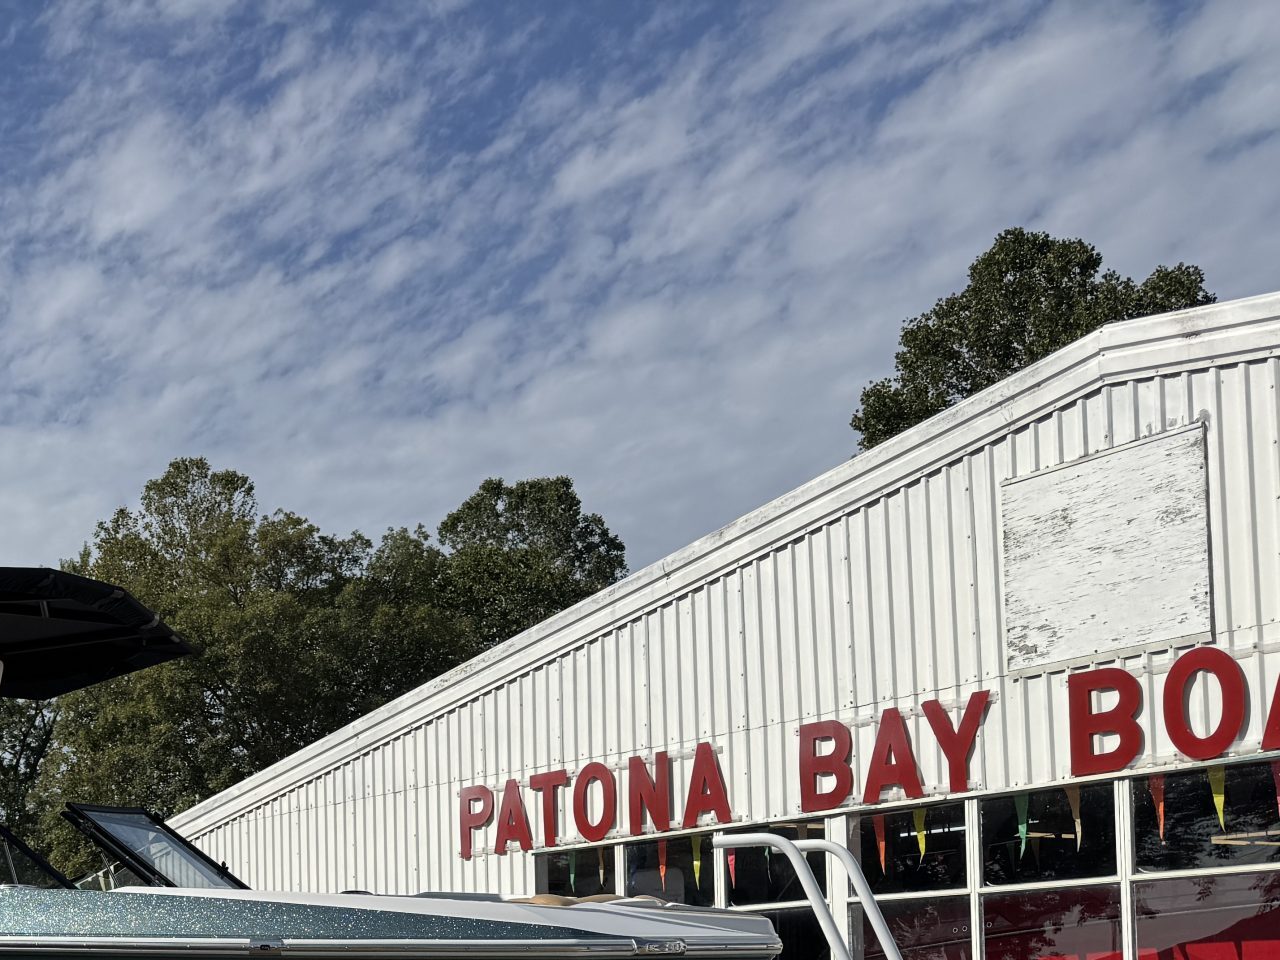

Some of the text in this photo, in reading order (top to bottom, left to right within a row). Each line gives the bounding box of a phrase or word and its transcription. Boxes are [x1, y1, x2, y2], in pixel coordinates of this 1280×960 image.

[459, 646, 1280, 861] PATONA BAY BO
